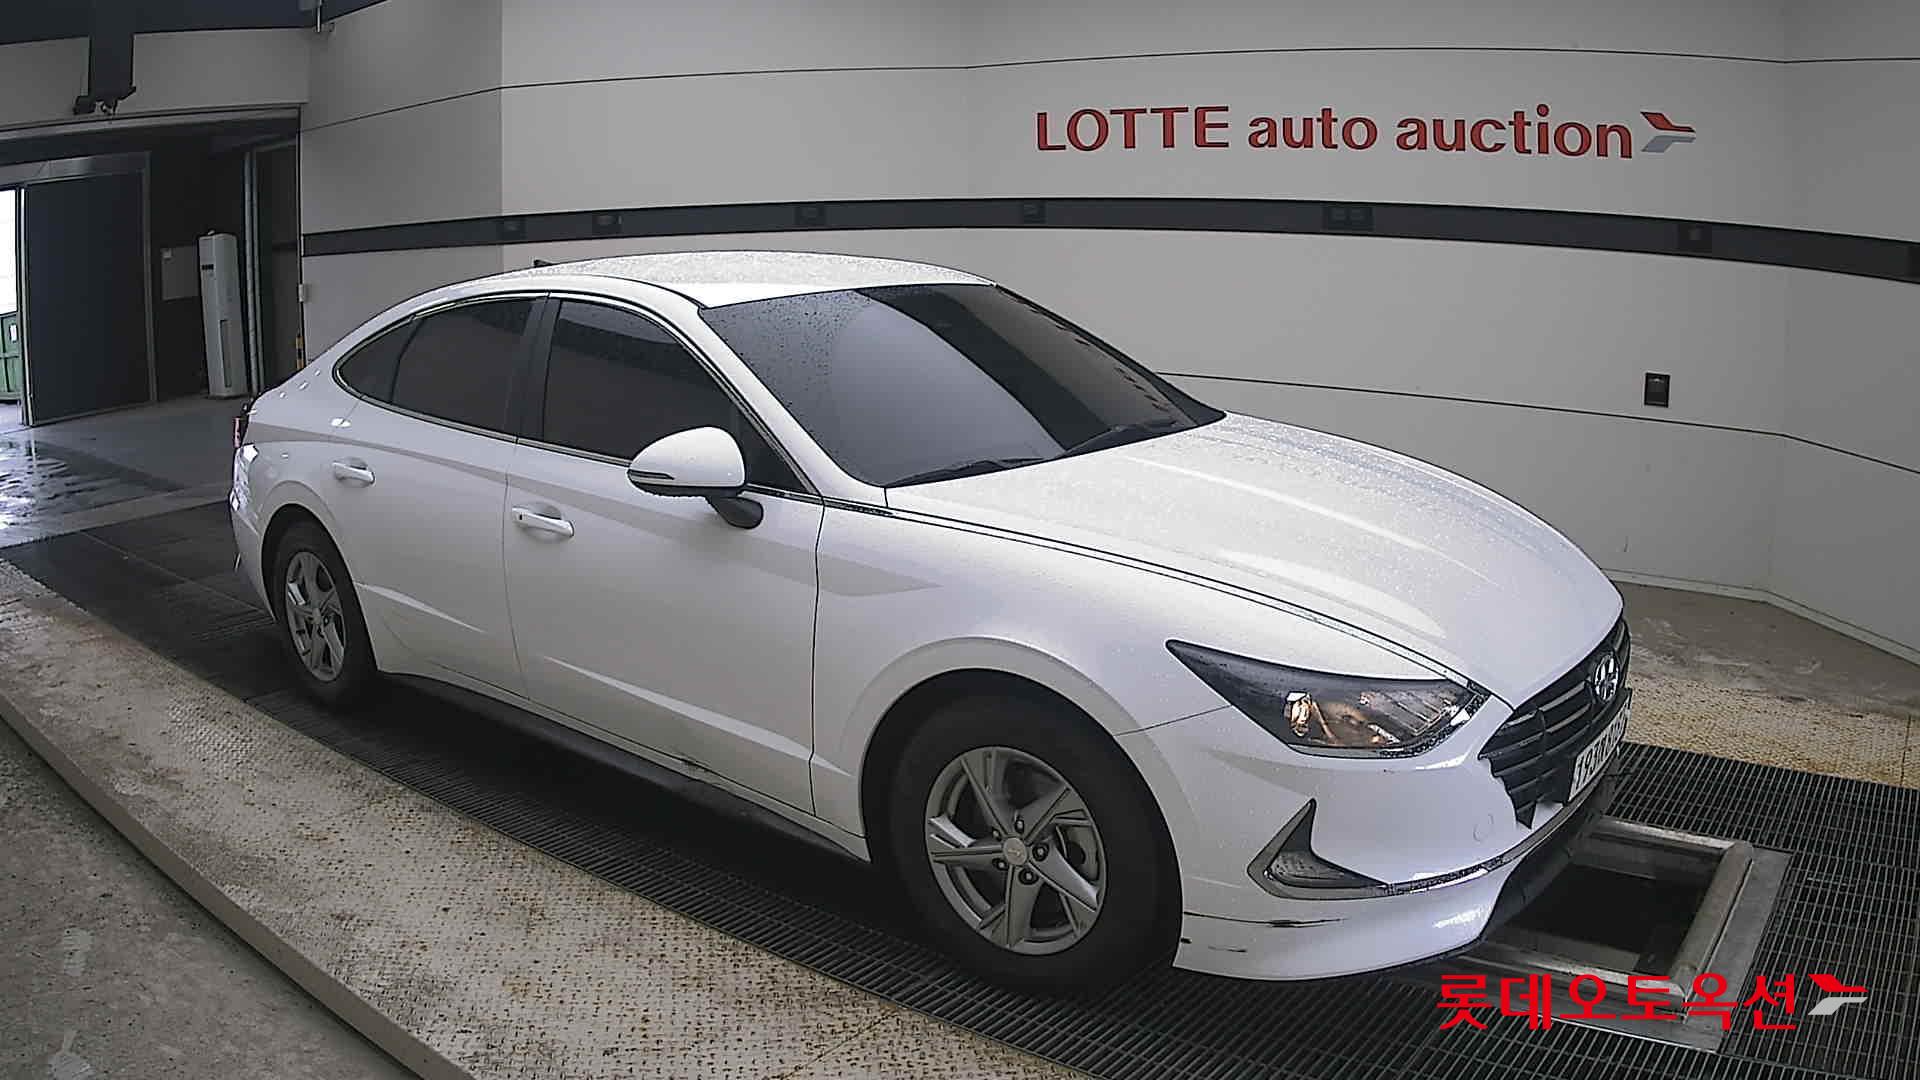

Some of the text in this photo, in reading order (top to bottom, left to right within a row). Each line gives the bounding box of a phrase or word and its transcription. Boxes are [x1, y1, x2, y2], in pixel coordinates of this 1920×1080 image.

[1036, 103, 1633, 158] LOTTE auto auction
